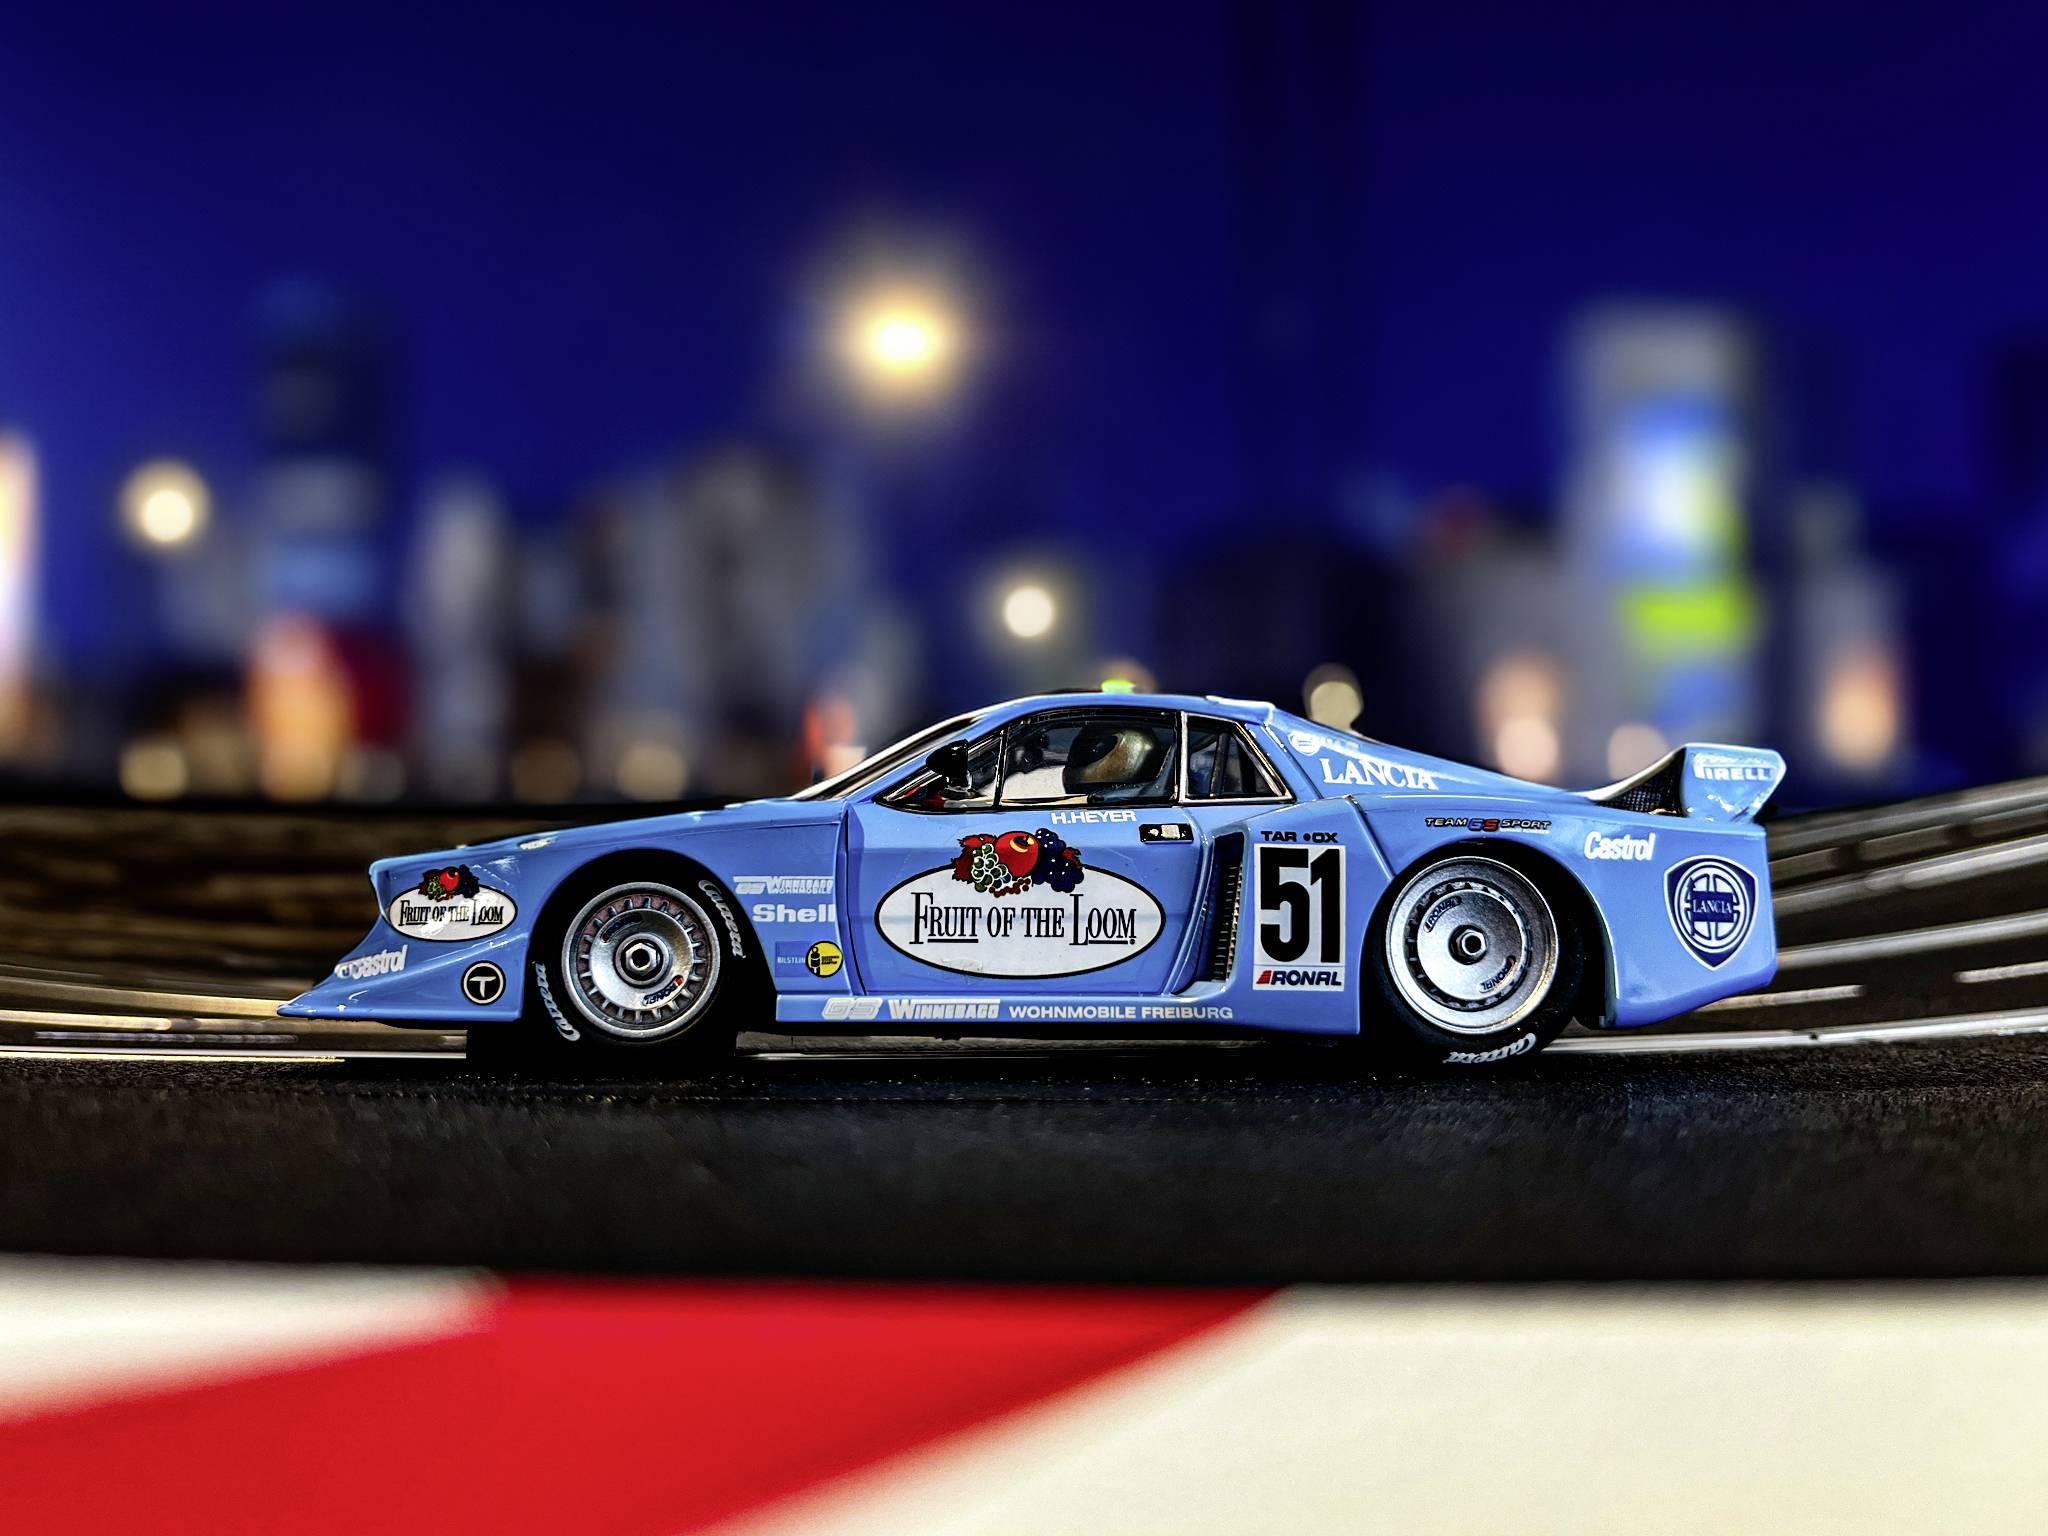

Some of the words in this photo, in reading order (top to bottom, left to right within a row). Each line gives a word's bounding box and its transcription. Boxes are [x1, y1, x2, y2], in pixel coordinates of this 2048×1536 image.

[1320, 758, 1439, 790] LANCIA
[1051, 810, 1137, 825] H.HEYER
[1425, 817, 1467, 828] TEAM
[1500, 819, 1552, 830] SPORT
[1260, 831, 1297, 842] TAR
[1584, 832, 1656, 861] Castrol
[398, 900, 430, 926] FRUIT
[431, 906, 446, 922] OF
[471, 899, 504, 926] LOOM
[752, 903, 835, 922] Shell
[1260, 847, 1340, 963] 51
[1693, 899, 1732, 914] LANCIA
[909, 892, 981, 945] FRUIT
[987, 907, 1015, 938] OF
[1021, 907, 1065, 938] THE
[1069, 893, 1136, 945] LOOM
[1270, 970, 1342, 986] RONAL
[1008, 1006, 1137, 1020] WOHNMOBILE
[1141, 1006, 1233, 1020] FREIBURG
